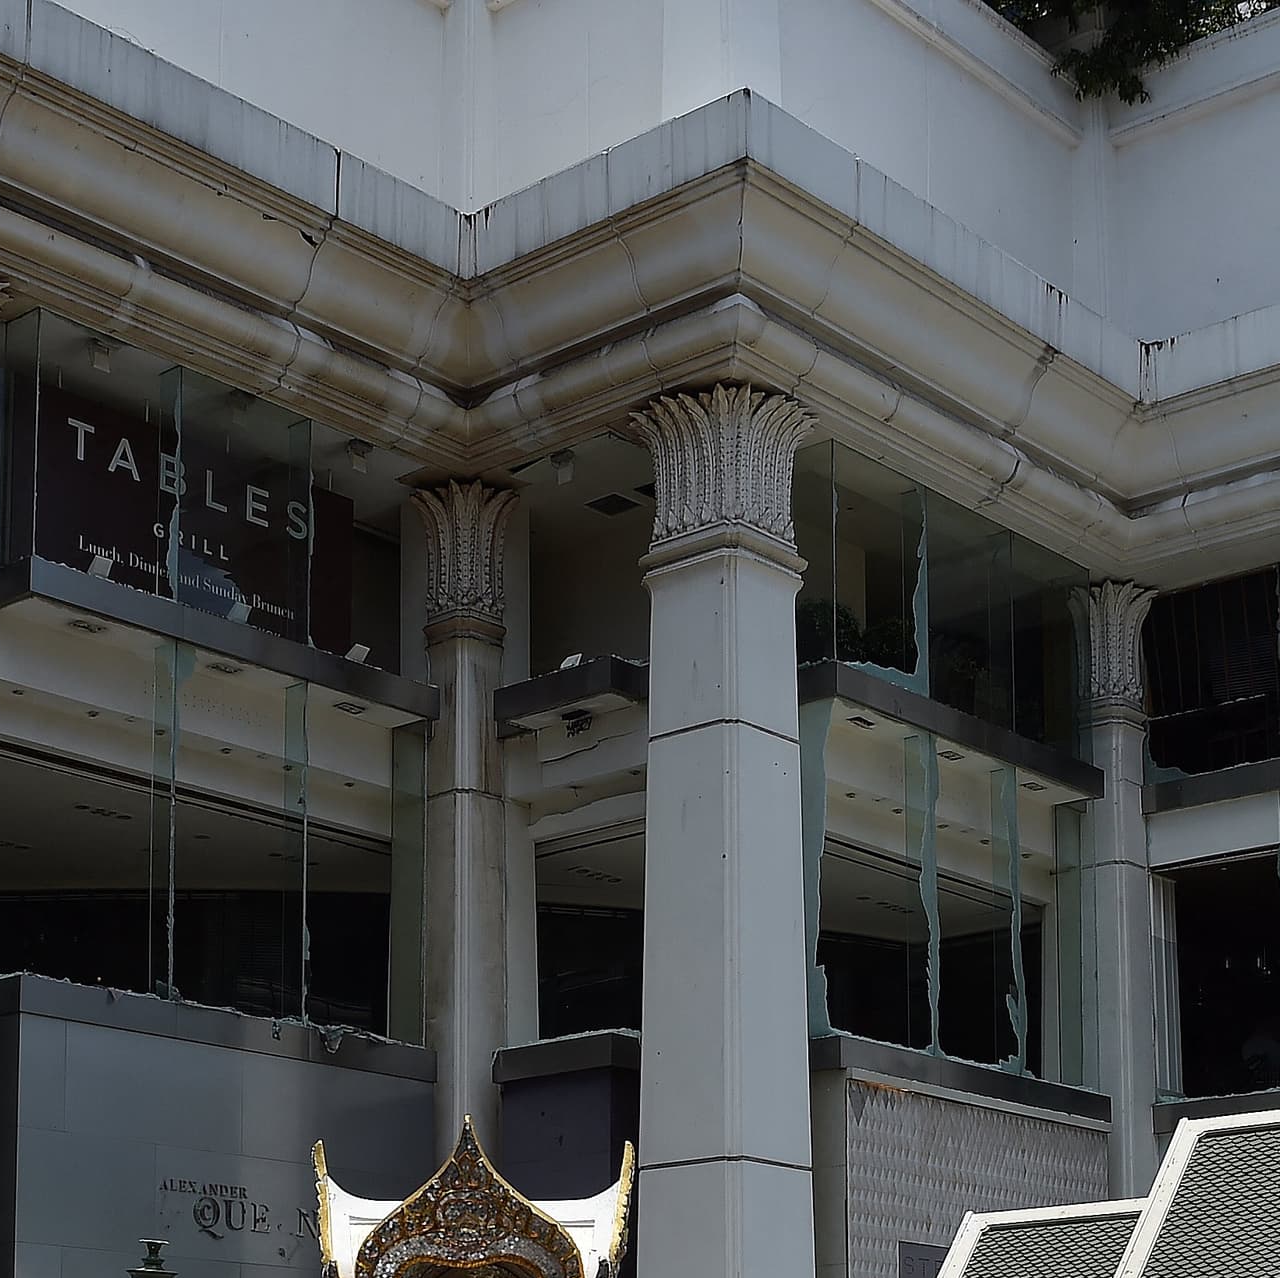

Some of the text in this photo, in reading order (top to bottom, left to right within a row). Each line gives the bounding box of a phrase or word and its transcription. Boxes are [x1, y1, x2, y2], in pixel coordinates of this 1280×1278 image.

[68, 417, 308, 540] TABLES
[203, 578, 249, 604] Sunday
[252, 593, 296, 621] Brunch
[159, 1178, 249, 1200] ALEXANDER
